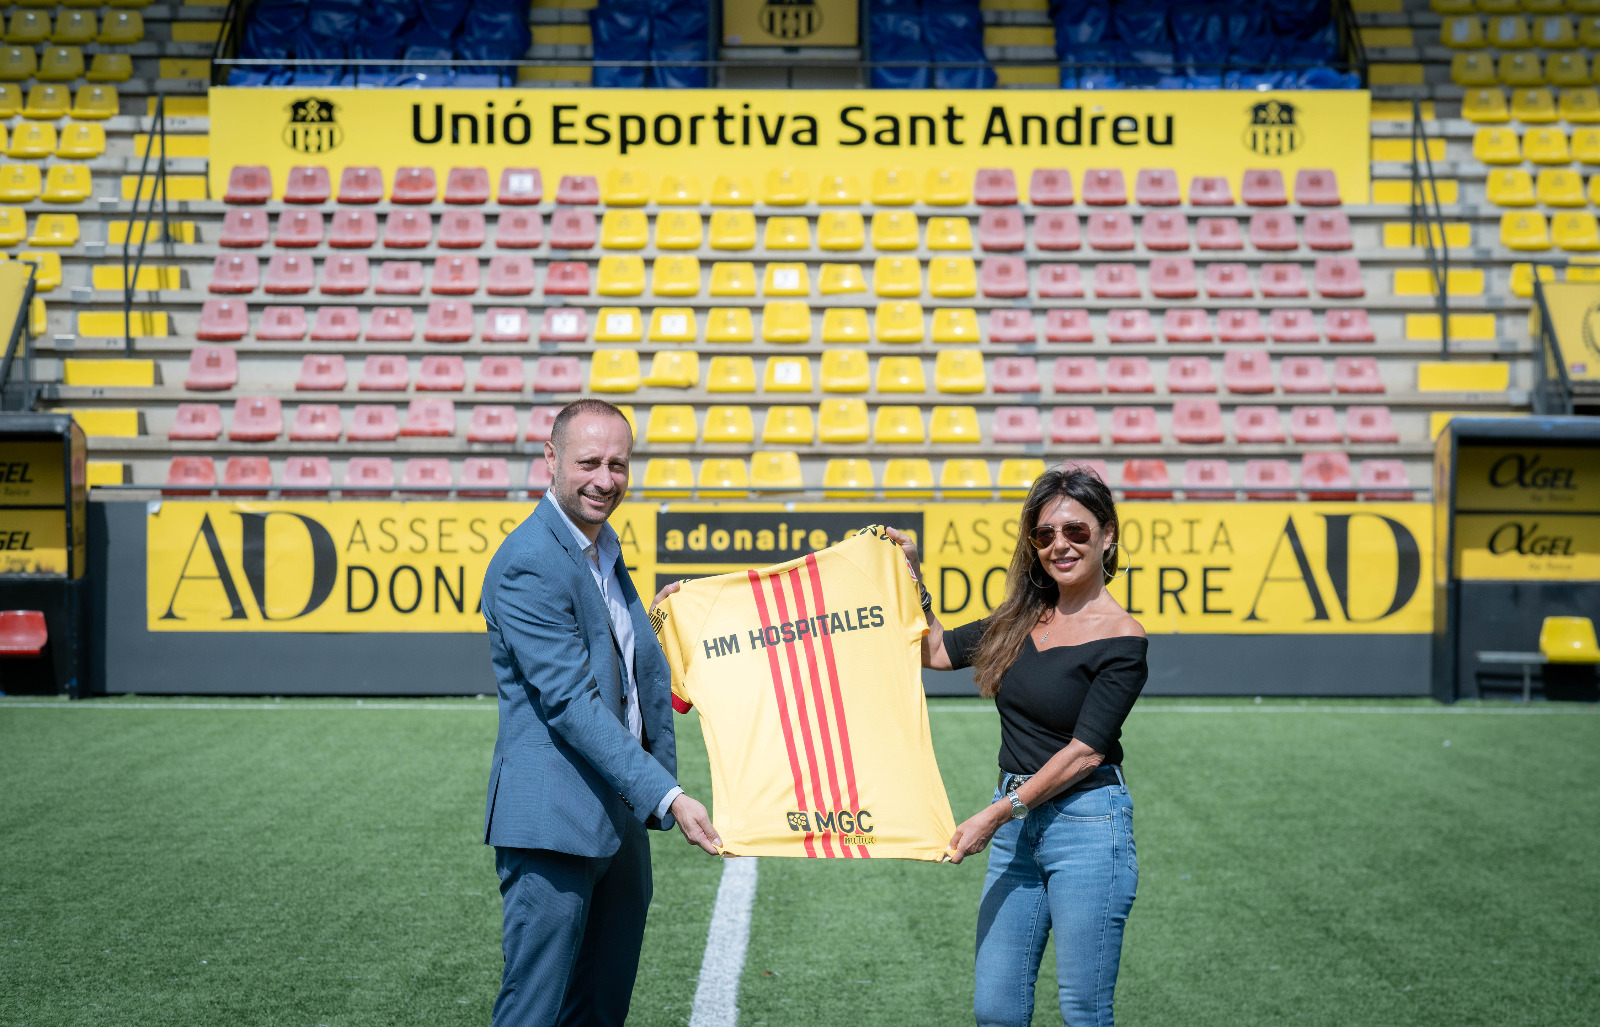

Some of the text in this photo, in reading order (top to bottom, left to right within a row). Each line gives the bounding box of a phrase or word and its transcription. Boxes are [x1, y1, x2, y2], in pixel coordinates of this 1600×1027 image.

[412, 100, 1174, 155] Unió Esportiva Sant Andreu
[158, 511, 338, 621] AD
[1243, 513, 1422, 622] AD
[703, 605, 885, 659] HM HOSPITALES
[814, 810, 874, 834] MGC
